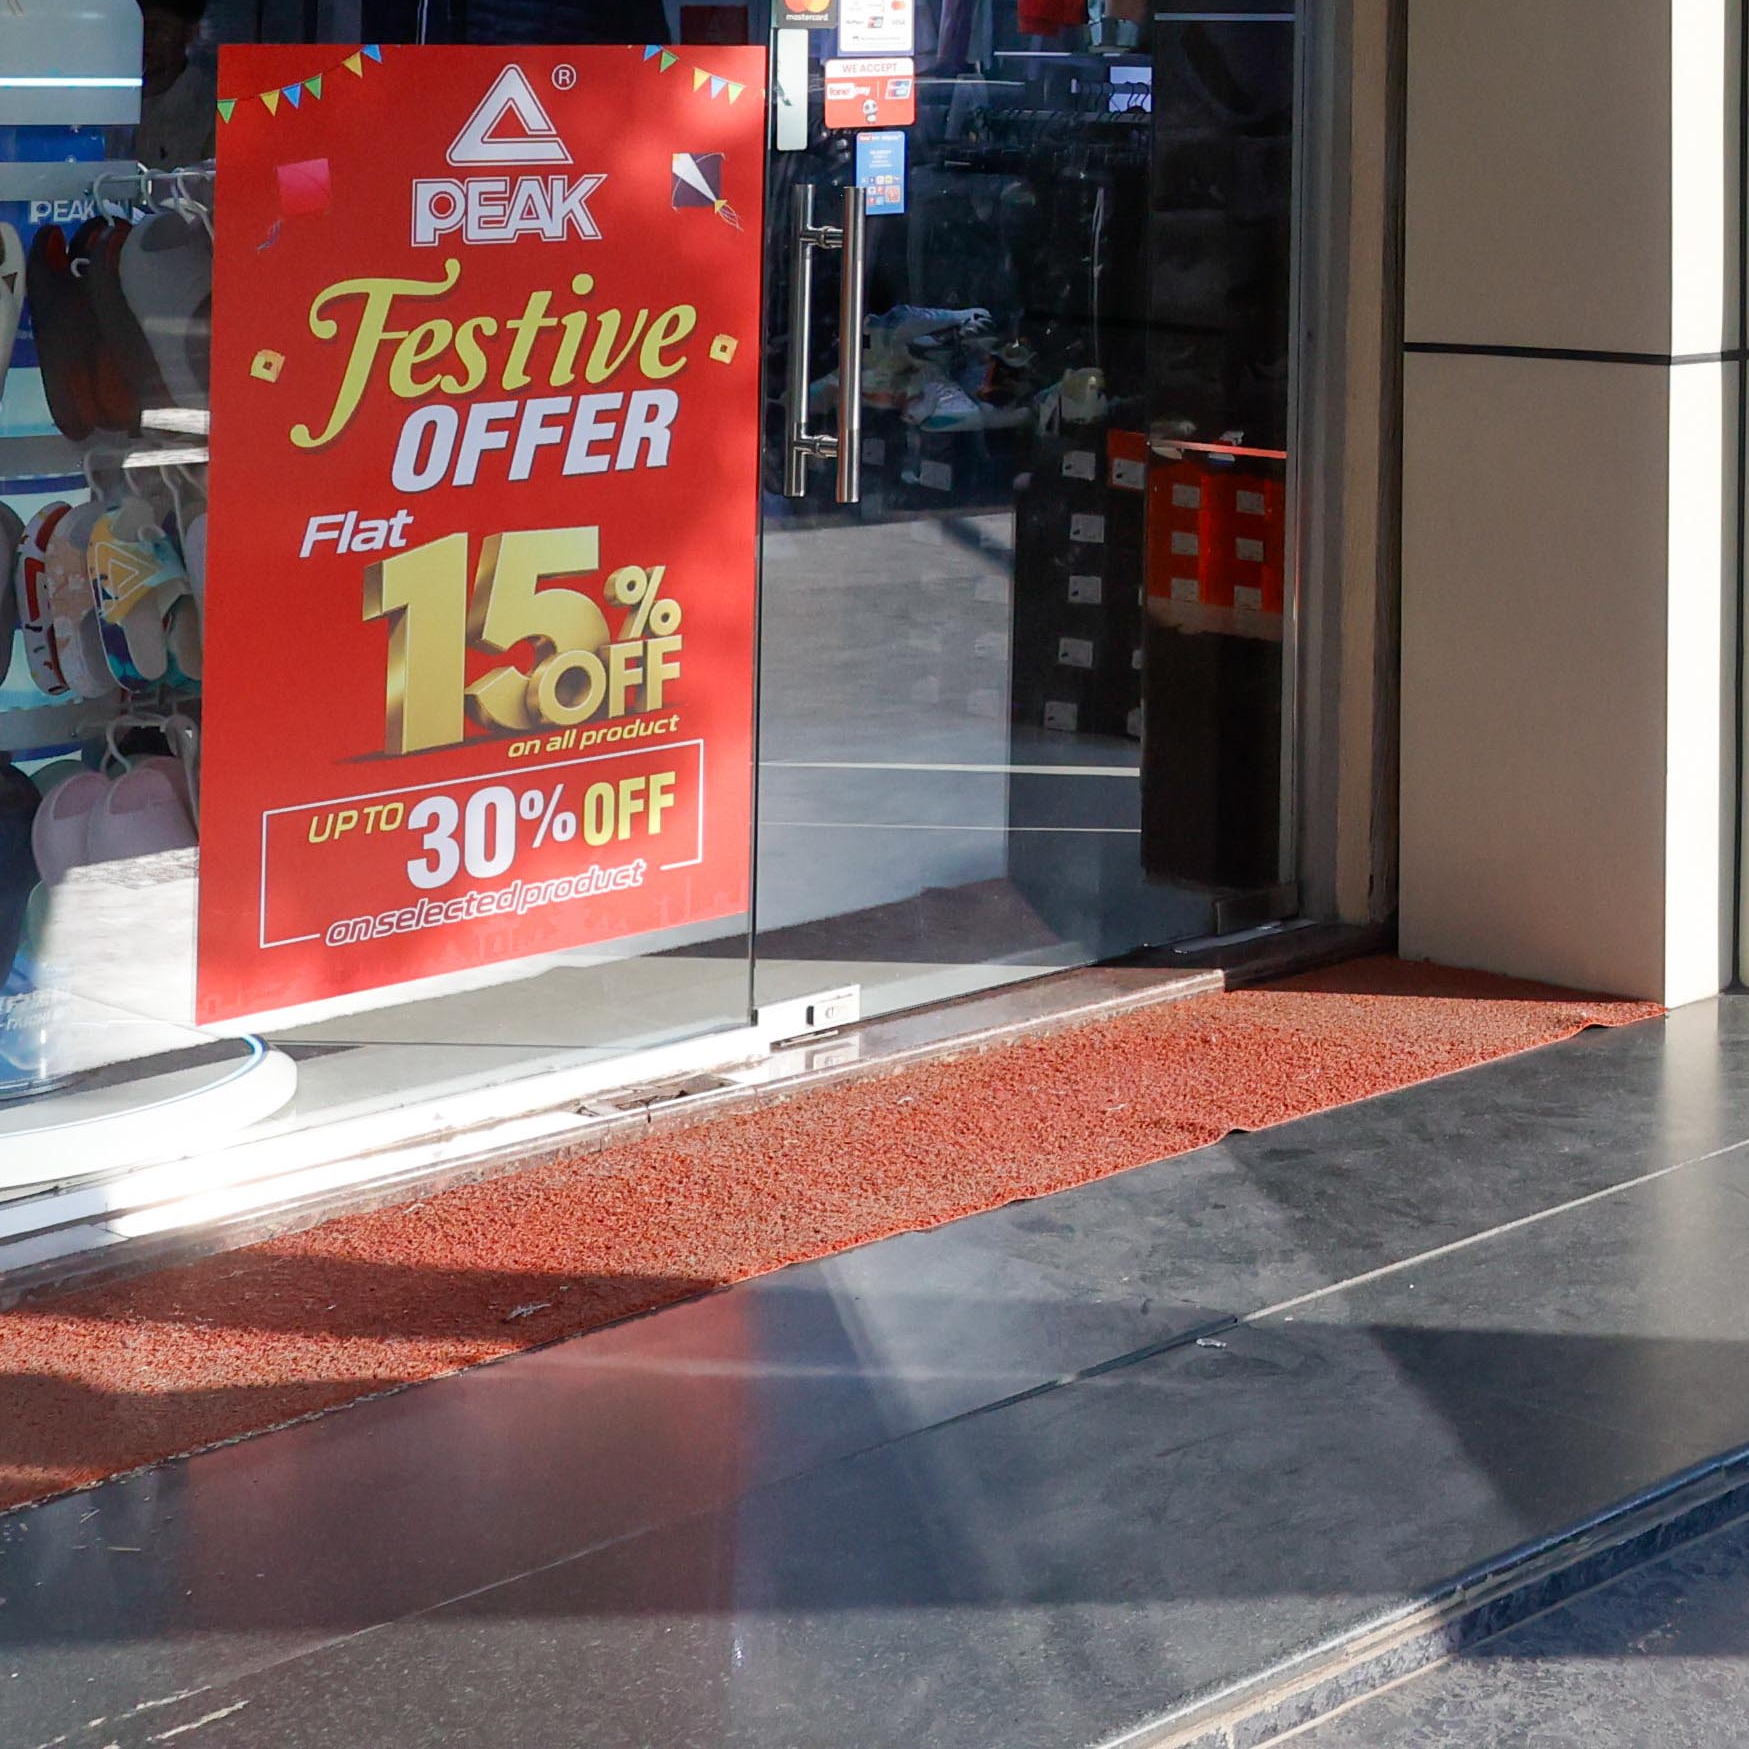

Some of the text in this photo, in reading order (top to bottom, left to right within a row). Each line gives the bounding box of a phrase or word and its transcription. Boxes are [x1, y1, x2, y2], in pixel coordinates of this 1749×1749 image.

[842, 63, 897, 74] WE ACCEPT
[410, 173, 608, 247] PEAK
[289, 257, 698, 449] Festive
[391, 388, 681, 494] OFFER
[299, 509, 414, 559] Flat
[527, 634, 683, 727] OFF
[507, 713, 681, 757] on all product
[308, 771, 677, 889] UP TO 30% OFF
[326, 859, 646, 946] on selected product
